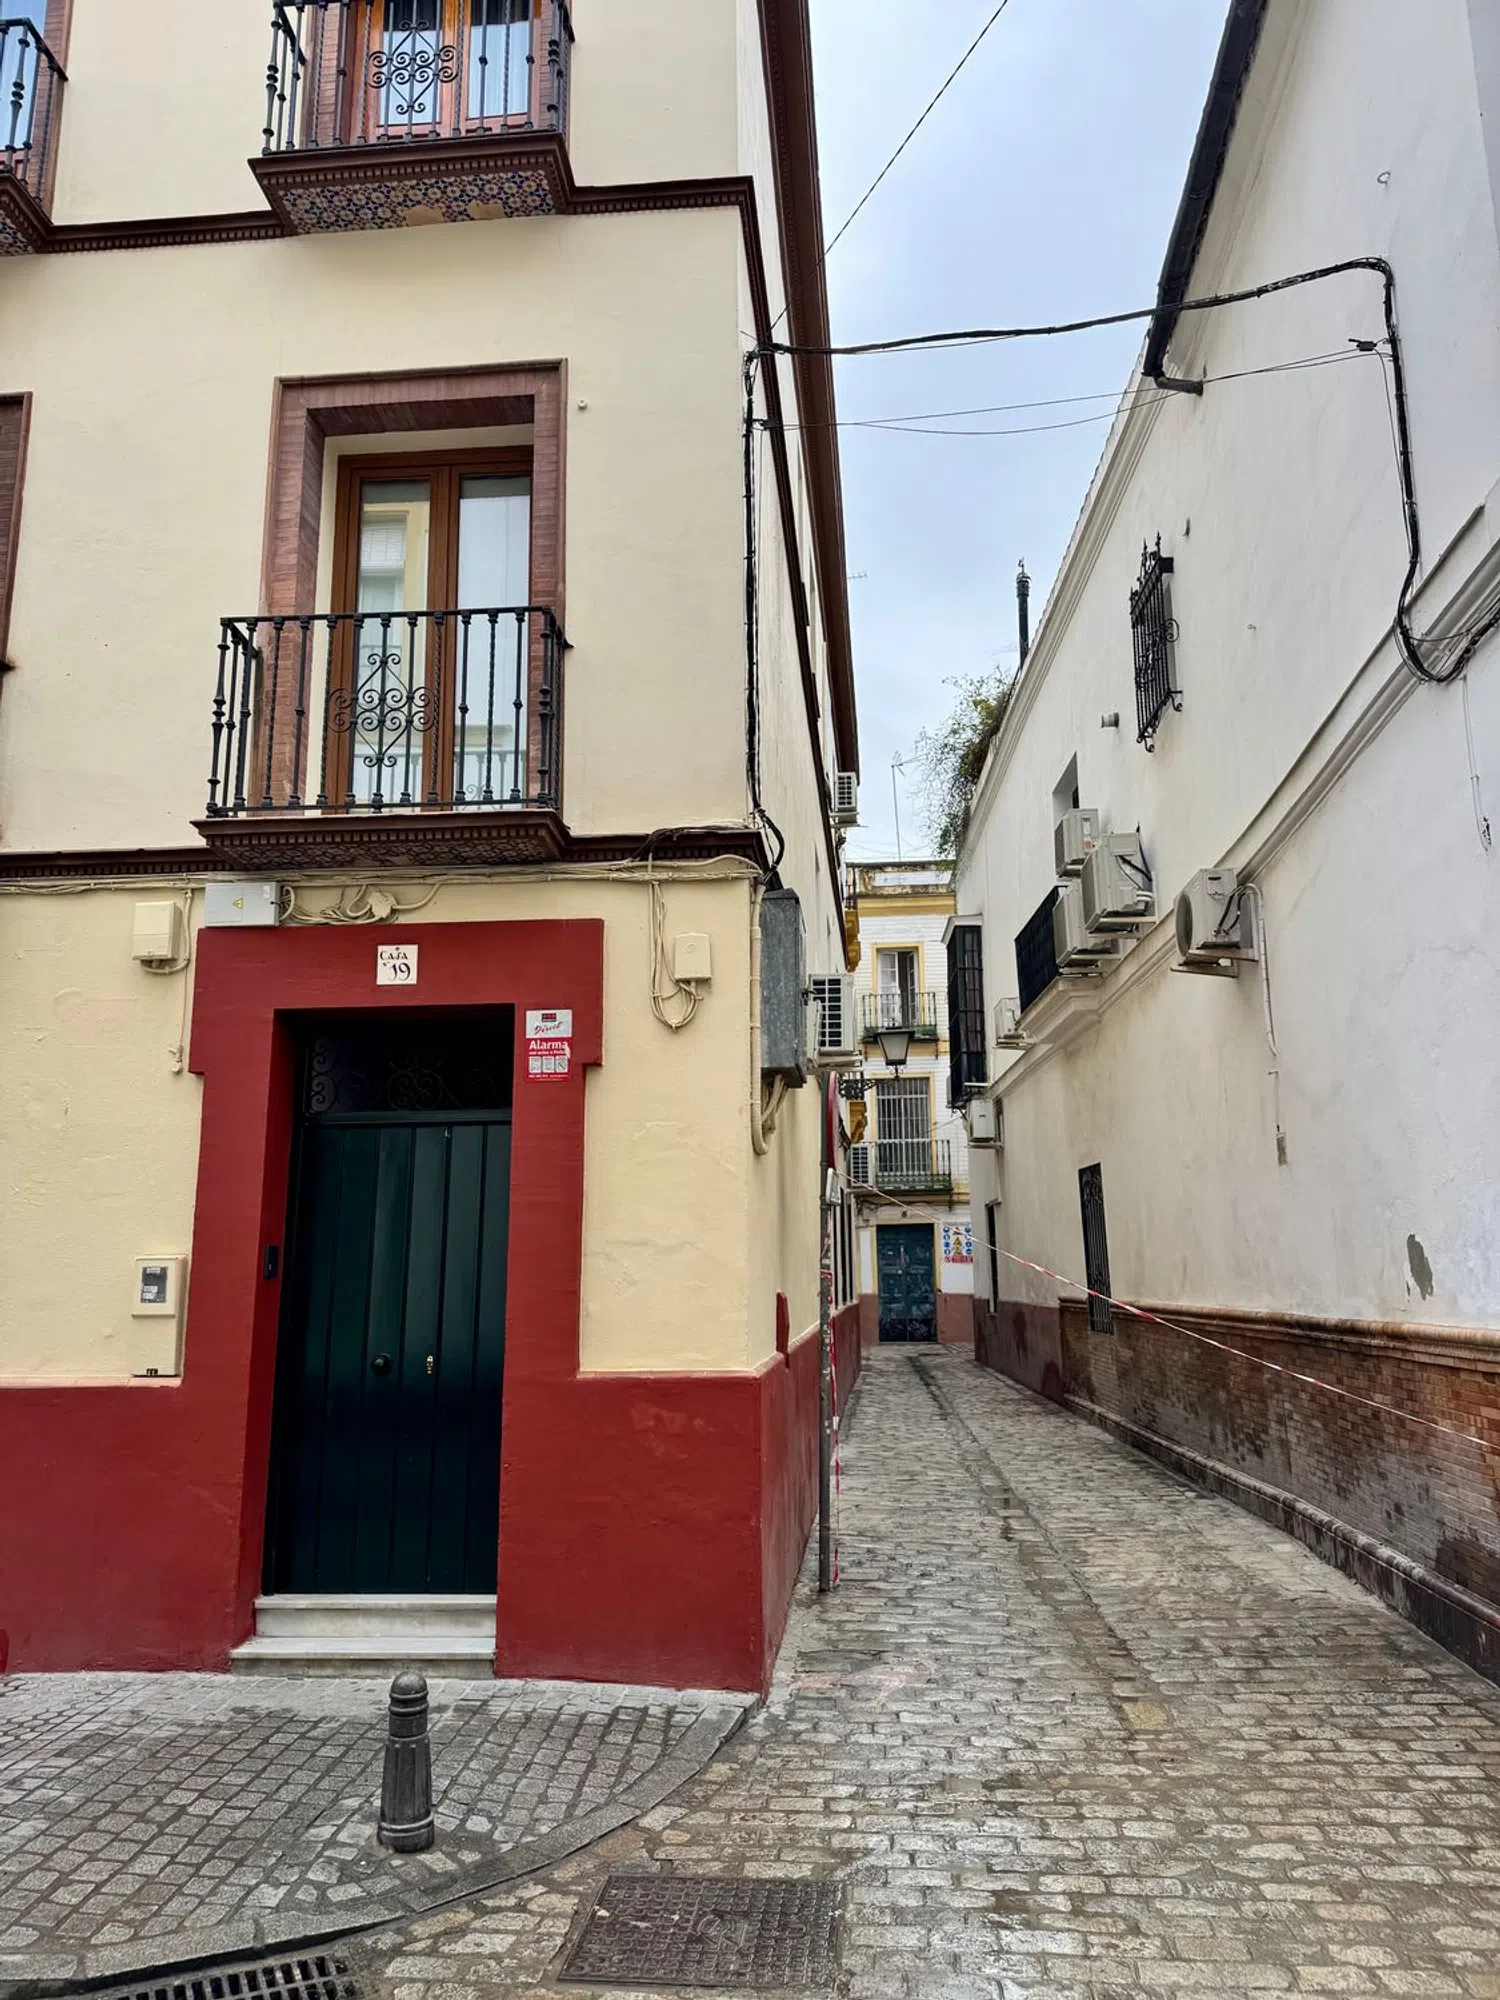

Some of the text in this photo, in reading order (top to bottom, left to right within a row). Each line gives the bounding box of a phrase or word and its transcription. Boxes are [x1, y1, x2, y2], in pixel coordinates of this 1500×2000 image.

[380, 950, 408, 960] Casa
[389, 963, 411, 981] 19
[529, 1040, 568, 1050] Alarma
